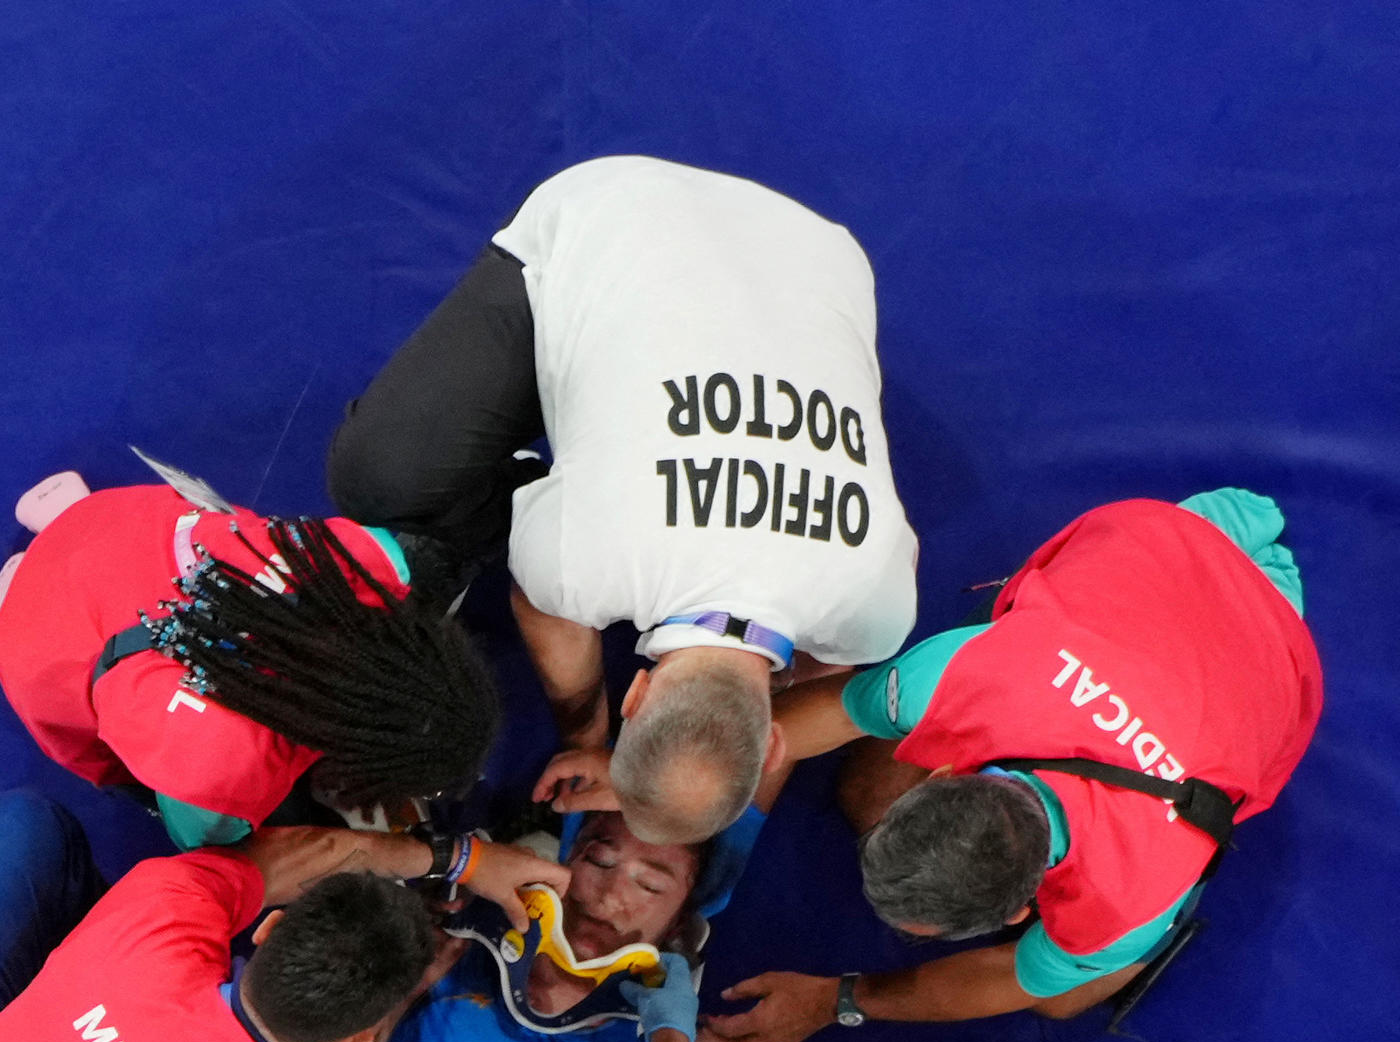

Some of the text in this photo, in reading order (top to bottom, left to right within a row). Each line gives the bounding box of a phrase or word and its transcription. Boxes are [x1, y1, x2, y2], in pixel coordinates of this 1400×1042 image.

[662, 372, 868, 466] DOCTOR
[656, 457, 870, 547] OFFICIAL
[1051, 649, 1186, 822] EDICAL
